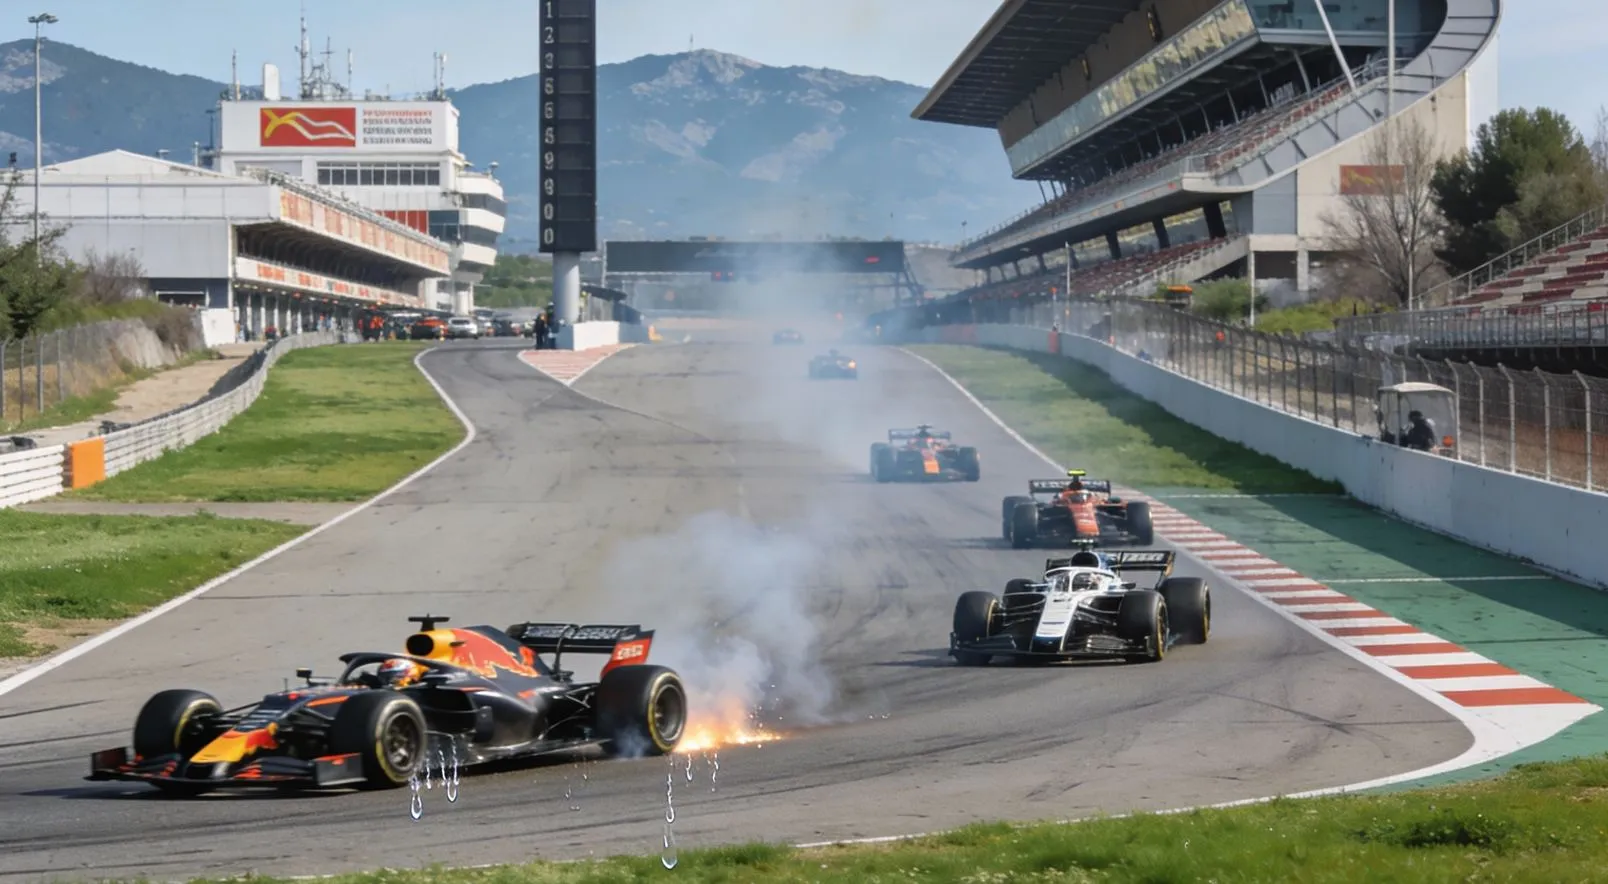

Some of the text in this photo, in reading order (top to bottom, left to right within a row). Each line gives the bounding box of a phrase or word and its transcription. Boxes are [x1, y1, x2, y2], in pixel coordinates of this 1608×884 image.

[547, 1, 553, 18] 1
[544, 26, 555, 44] 2
[544, 227, 554, 244] 0
